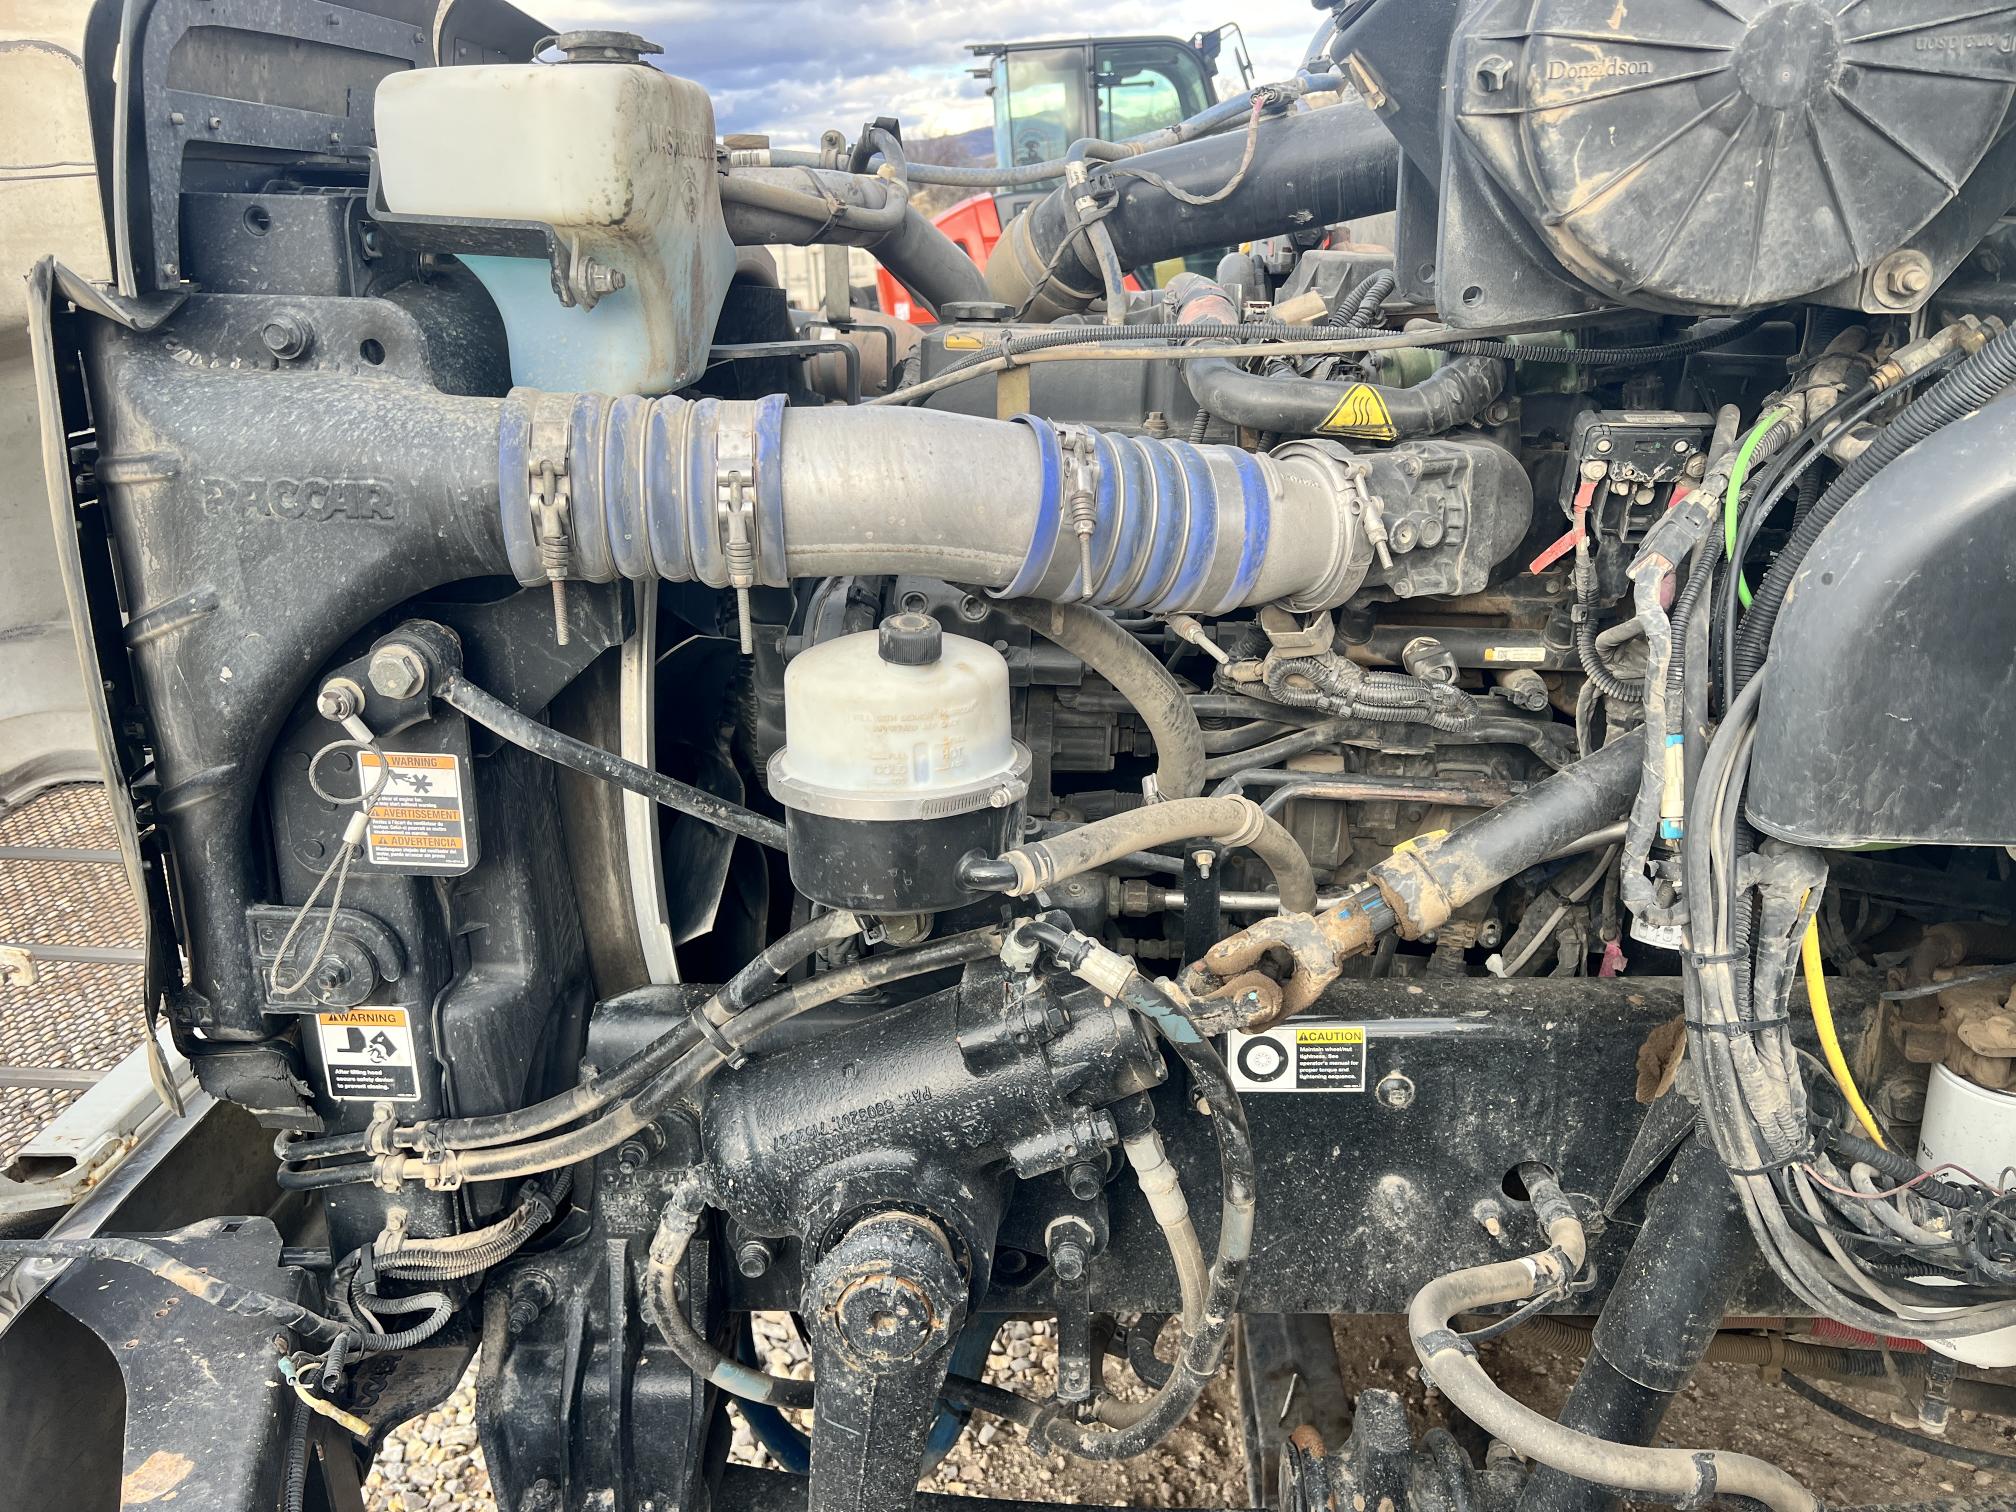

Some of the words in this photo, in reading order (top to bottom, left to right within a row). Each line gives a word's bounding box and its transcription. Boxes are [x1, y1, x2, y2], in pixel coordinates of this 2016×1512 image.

[1547, 56, 1653, 80] Donaldson
[201, 476, 396, 522] PACCAR
[391, 756, 438, 767] WARNING
[384, 808, 457, 820] AVERTISSEMENT
[391, 836, 457, 847] ADVERTENCIA
[339, 1013, 397, 1023] WARNING
[1309, 1031, 1361, 1041] CAUTION
